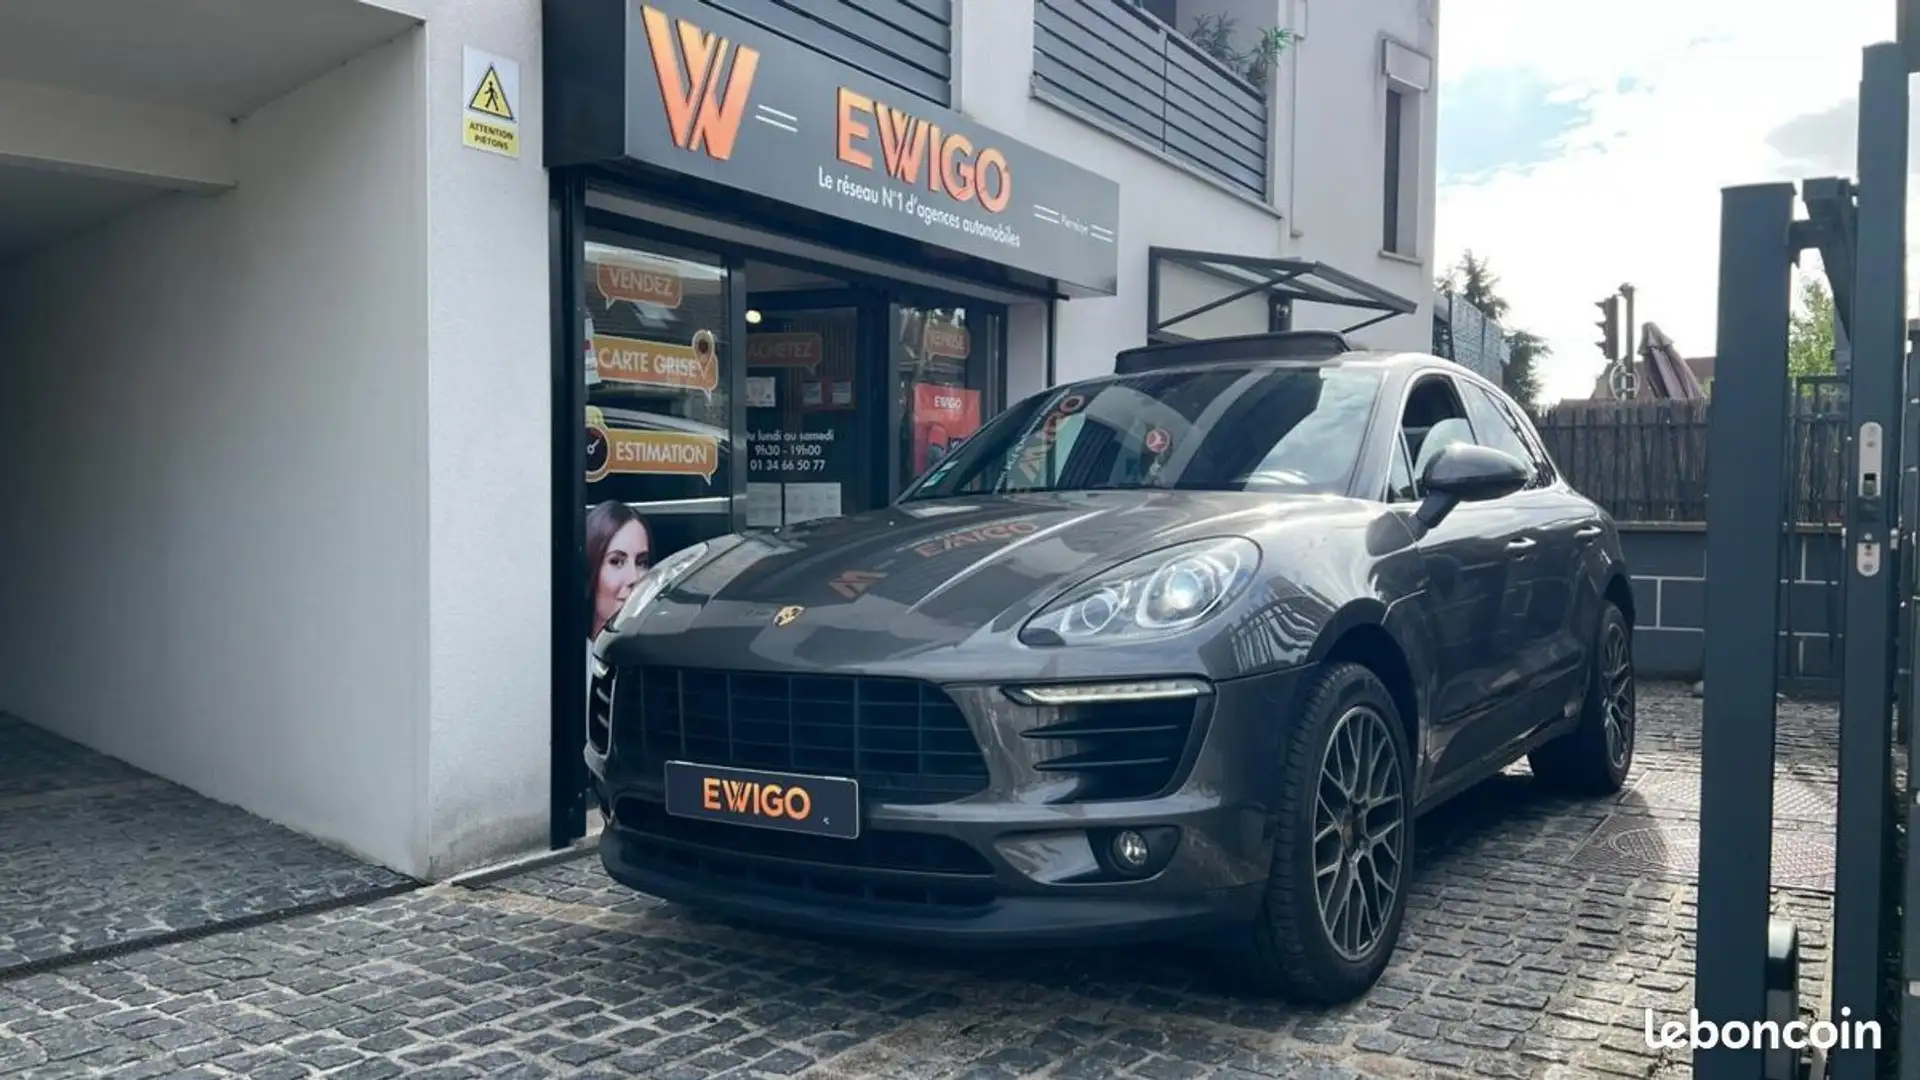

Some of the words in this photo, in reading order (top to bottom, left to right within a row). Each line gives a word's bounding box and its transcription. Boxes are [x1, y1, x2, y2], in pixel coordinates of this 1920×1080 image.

[470, 122, 513, 140] ATTENTION
[836, 86, 1012, 214] EWIGO
[819, 167, 833, 189] Le
[836, 173, 880, 205] réseau
[962, 218, 1021, 248] automobiles
[610, 267, 672, 296] VENDEZ
[598, 346, 650, 373] CARTE
[652, 353, 698, 378] GRISE
[933, 395, 962, 410] EWIGO
[757, 429, 782, 441] lundi
[783, 432, 797, 441] au
[799, 428, 835, 441] samedi
[615, 441, 708, 465] ESTIMATION
[755, 443, 781, 456] 9h30
[790, 443, 823, 456] 19h00
[750, 459, 764, 471] 01
[766, 459, 780, 471] 34
[781, 459, 796, 471] 66
[797, 459, 811, 471] 50
[812, 459, 826, 472] 77
[703, 777, 812, 821] EWIGO
